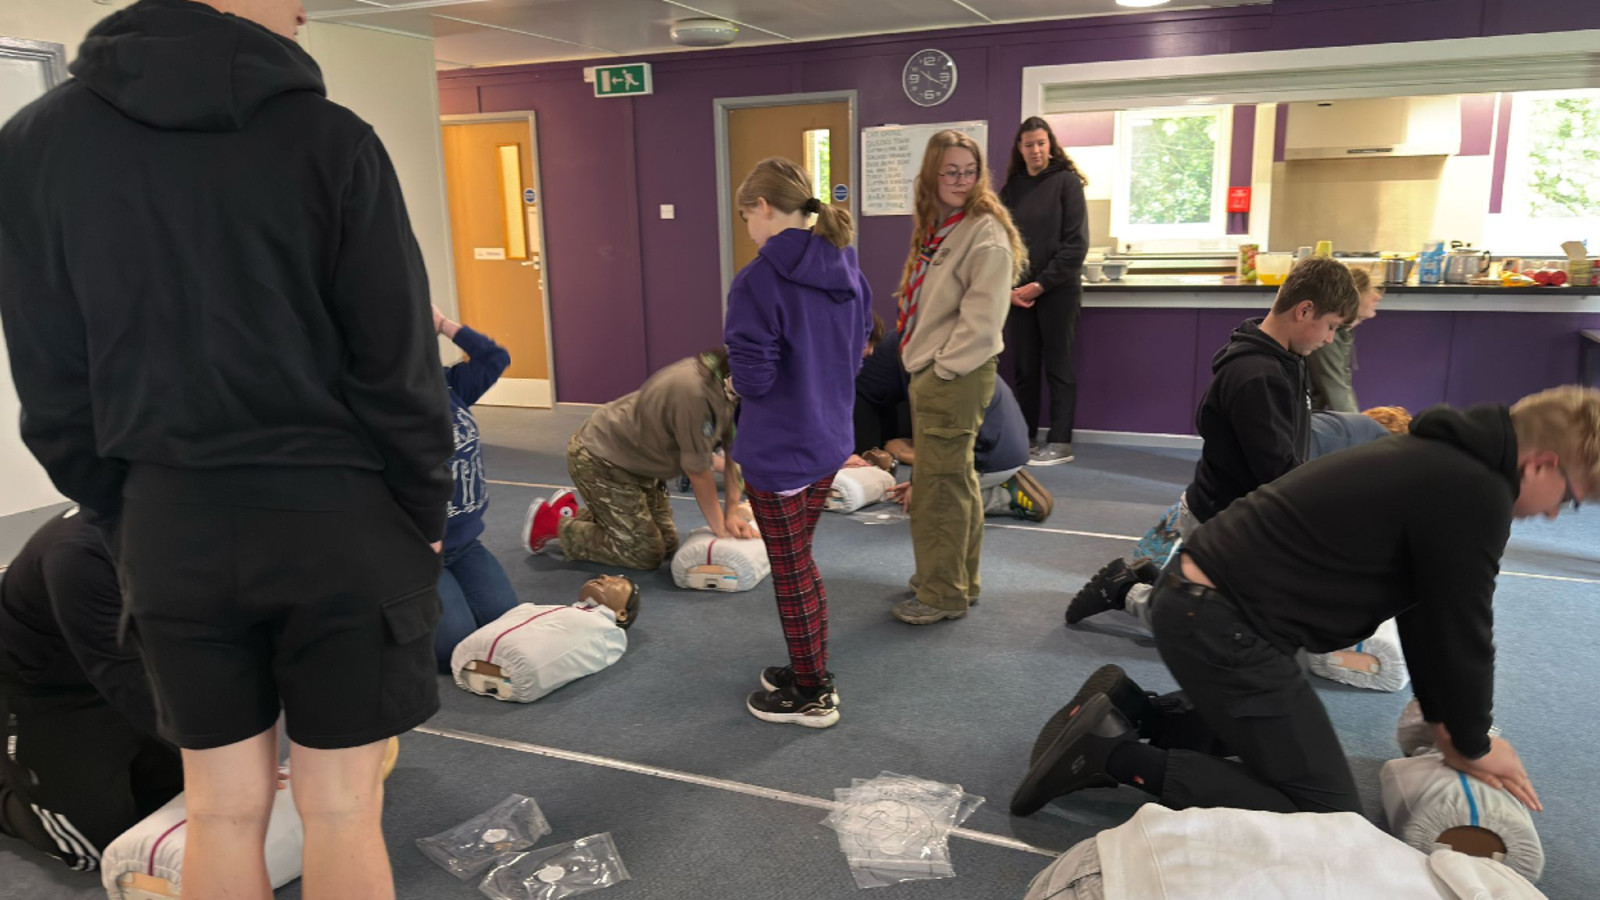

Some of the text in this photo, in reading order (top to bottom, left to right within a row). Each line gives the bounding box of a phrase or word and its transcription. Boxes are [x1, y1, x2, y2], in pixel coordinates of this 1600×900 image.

[923, 56, 936, 66] 12
[909, 74, 919, 84] 9
[939, 72, 950, 82] 3
[924, 89, 935, 100] 6
